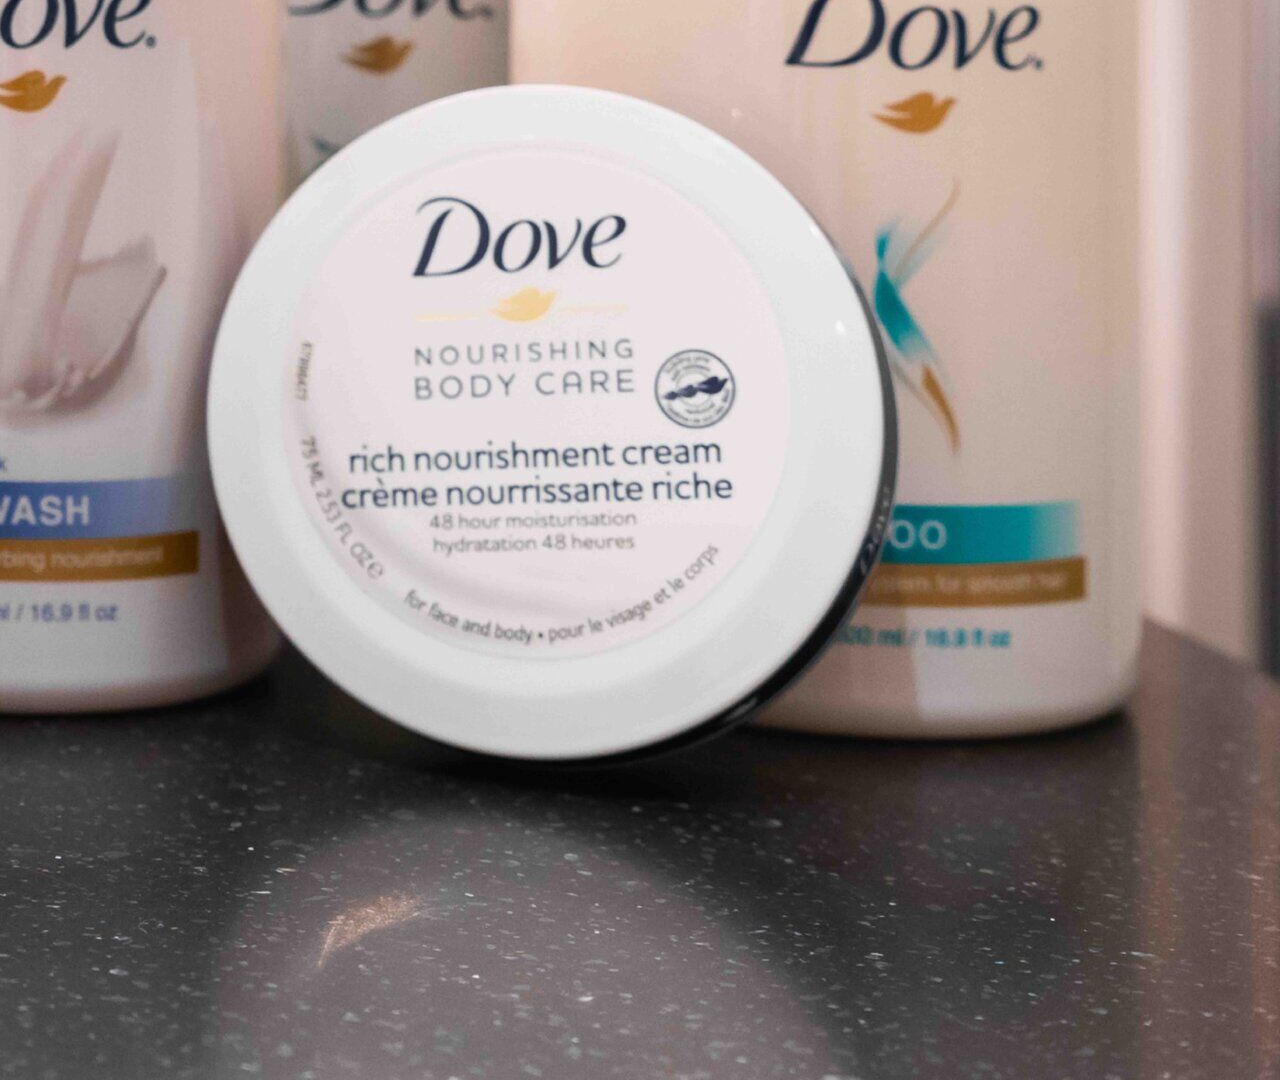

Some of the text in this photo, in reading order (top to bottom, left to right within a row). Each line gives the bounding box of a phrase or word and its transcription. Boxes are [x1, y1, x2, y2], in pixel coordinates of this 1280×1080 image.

[412, 196, 627, 278] Dove
[413, 338, 634, 366] NOURISHING
[413, 369, 635, 401] BODY CARE
[349, 441, 722, 473] rich nourishment cream
[341, 470, 733, 509] crème nourrissante riche
[429, 510, 638, 530] 48 hour moisturisation
[433, 533, 636, 557] hydratation 48 heures
[404, 543, 720, 645] for face and body pour le visage et le corps
[31, 603, 73, 622] 16.9
